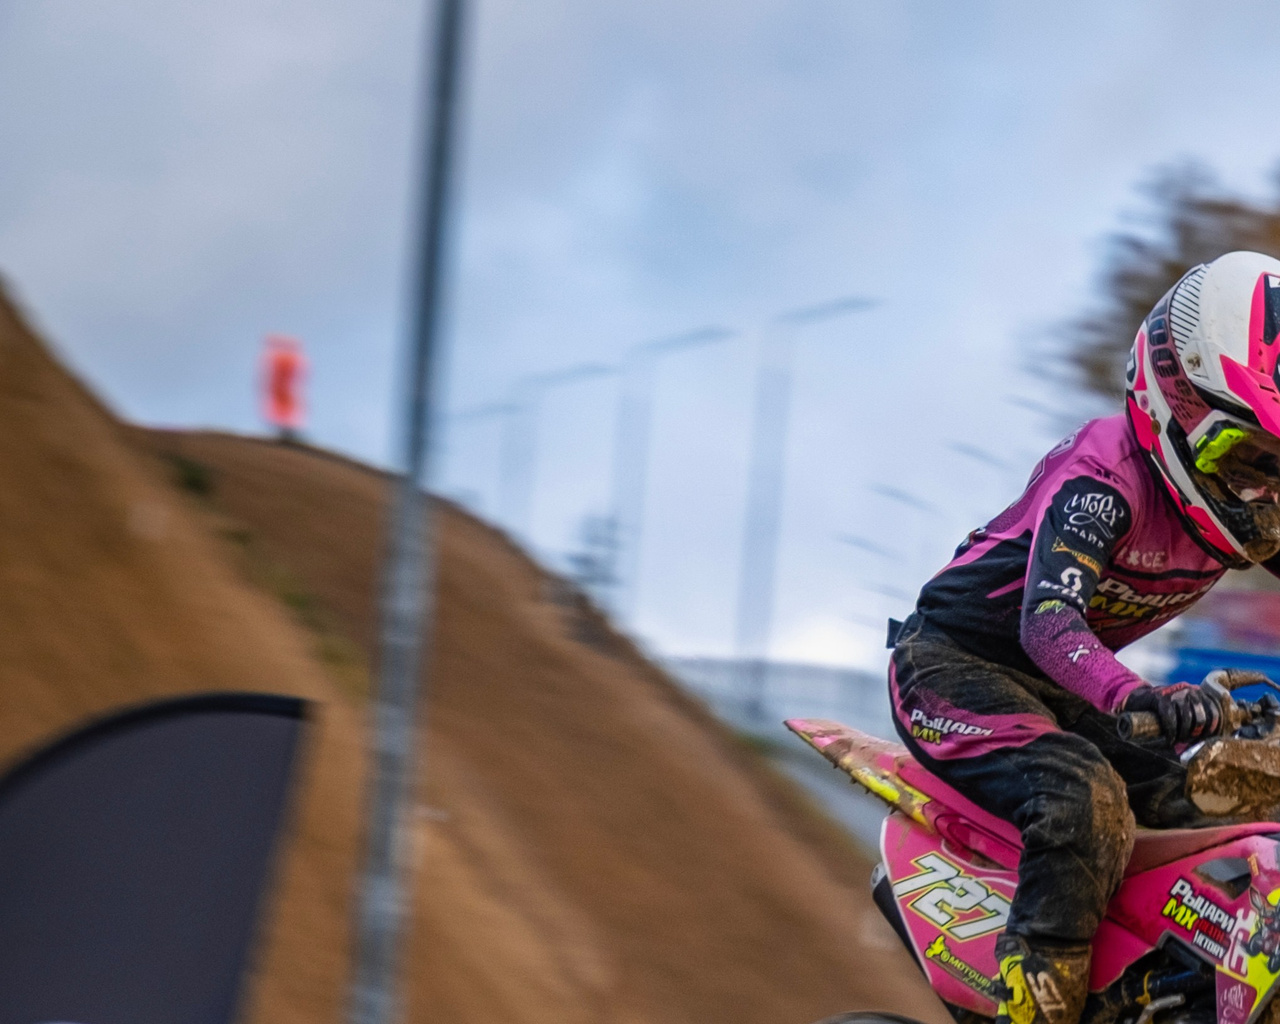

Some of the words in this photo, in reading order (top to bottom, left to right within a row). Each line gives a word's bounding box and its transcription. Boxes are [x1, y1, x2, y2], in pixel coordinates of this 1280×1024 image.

[892, 850, 1012, 943] 727
[1161, 896, 1199, 931] MX
[1169, 877, 1237, 933] РЫЦАРИ
